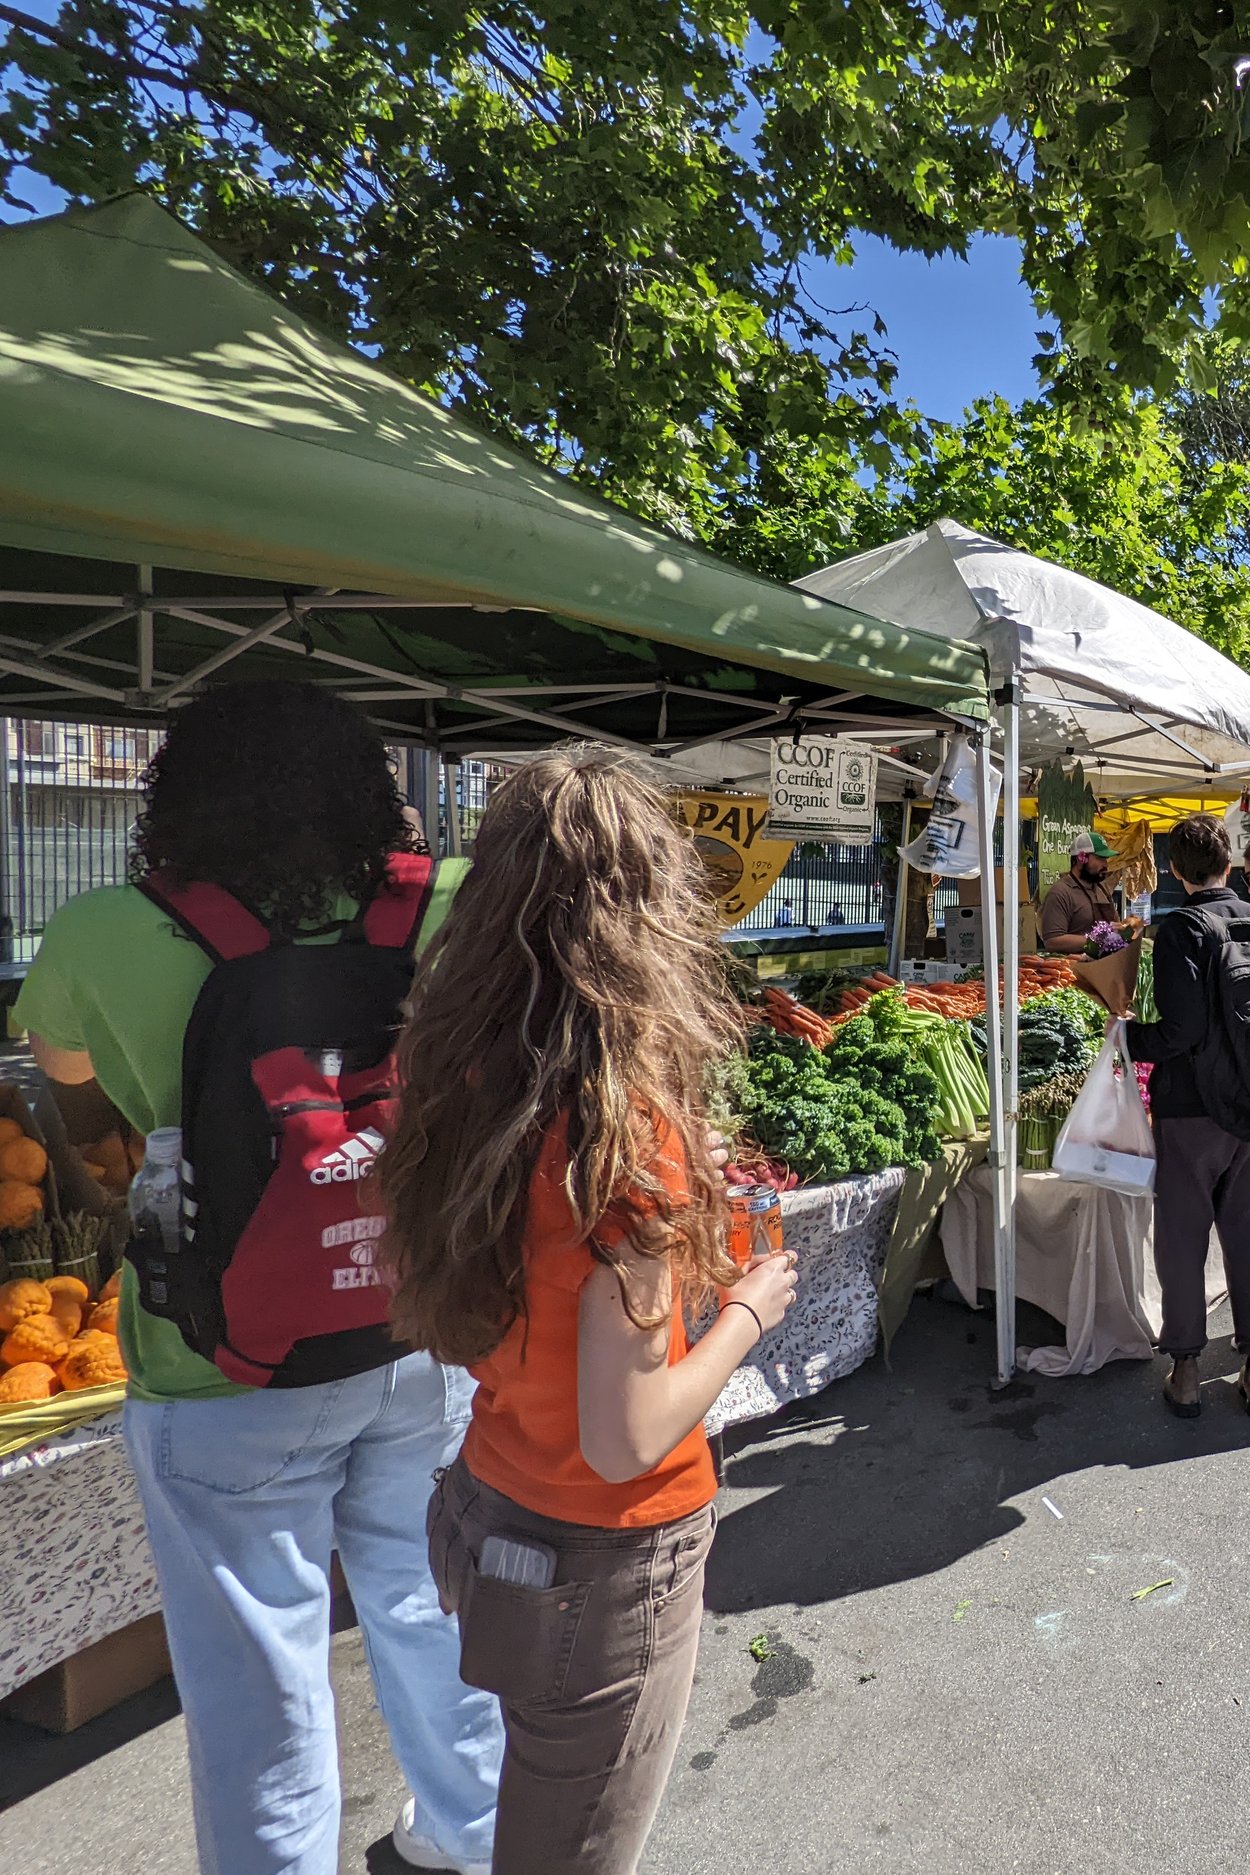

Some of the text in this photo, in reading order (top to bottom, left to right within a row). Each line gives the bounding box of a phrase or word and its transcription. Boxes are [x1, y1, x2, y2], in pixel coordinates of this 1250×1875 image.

[777, 742, 835, 768] CCOF
[845, 750, 868, 758] Certified
[776, 769, 833, 788] Certified
[842, 781, 866, 793] CCOF
[775, 789, 830, 812] Organic
[842, 805, 862, 814] Organic
[1042, 814, 1061, 833] Green
[1042, 838, 1055, 854] One
[751, 860, 773, 870] 1976
[1041, 868, 1054, 885] Two
